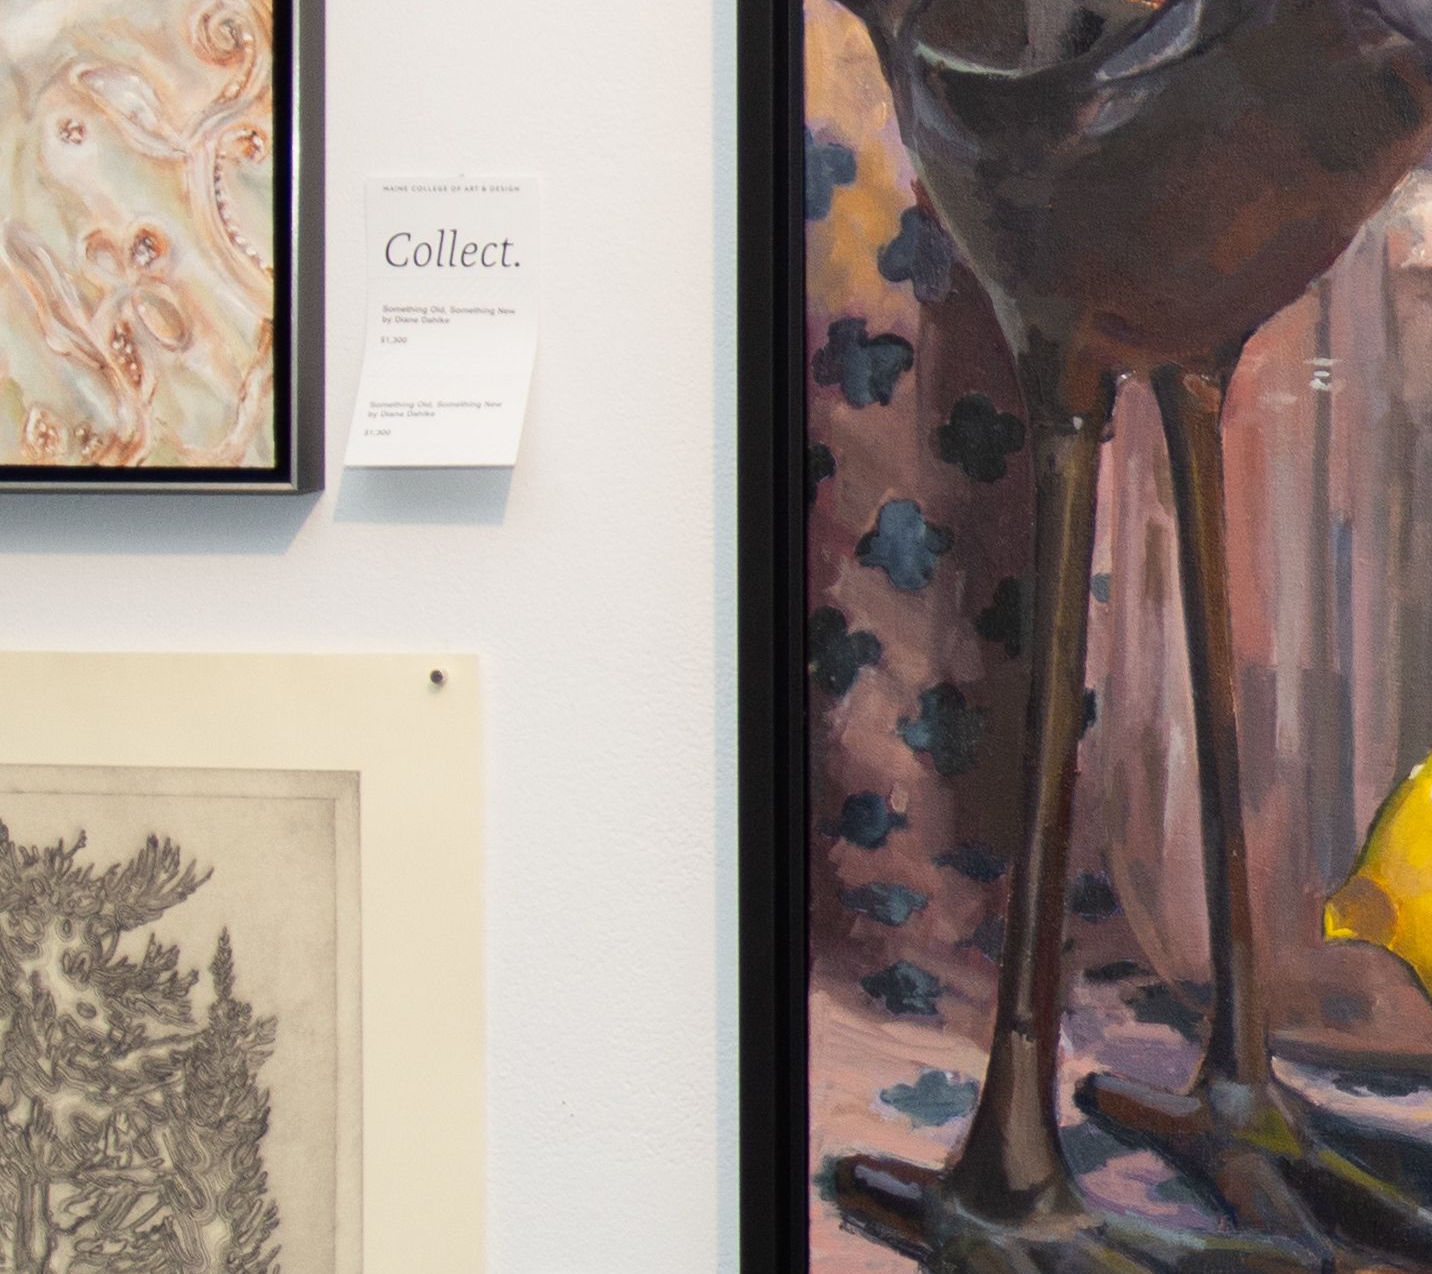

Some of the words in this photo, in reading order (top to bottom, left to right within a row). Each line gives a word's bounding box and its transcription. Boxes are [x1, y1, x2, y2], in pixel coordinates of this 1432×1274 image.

[385, 229, 520, 267] Collect.
[383, 305, 427, 314] Something
[450, 307, 495, 315] Something
[382, 316, 391, 325] by
[370, 401, 414, 409] Something
